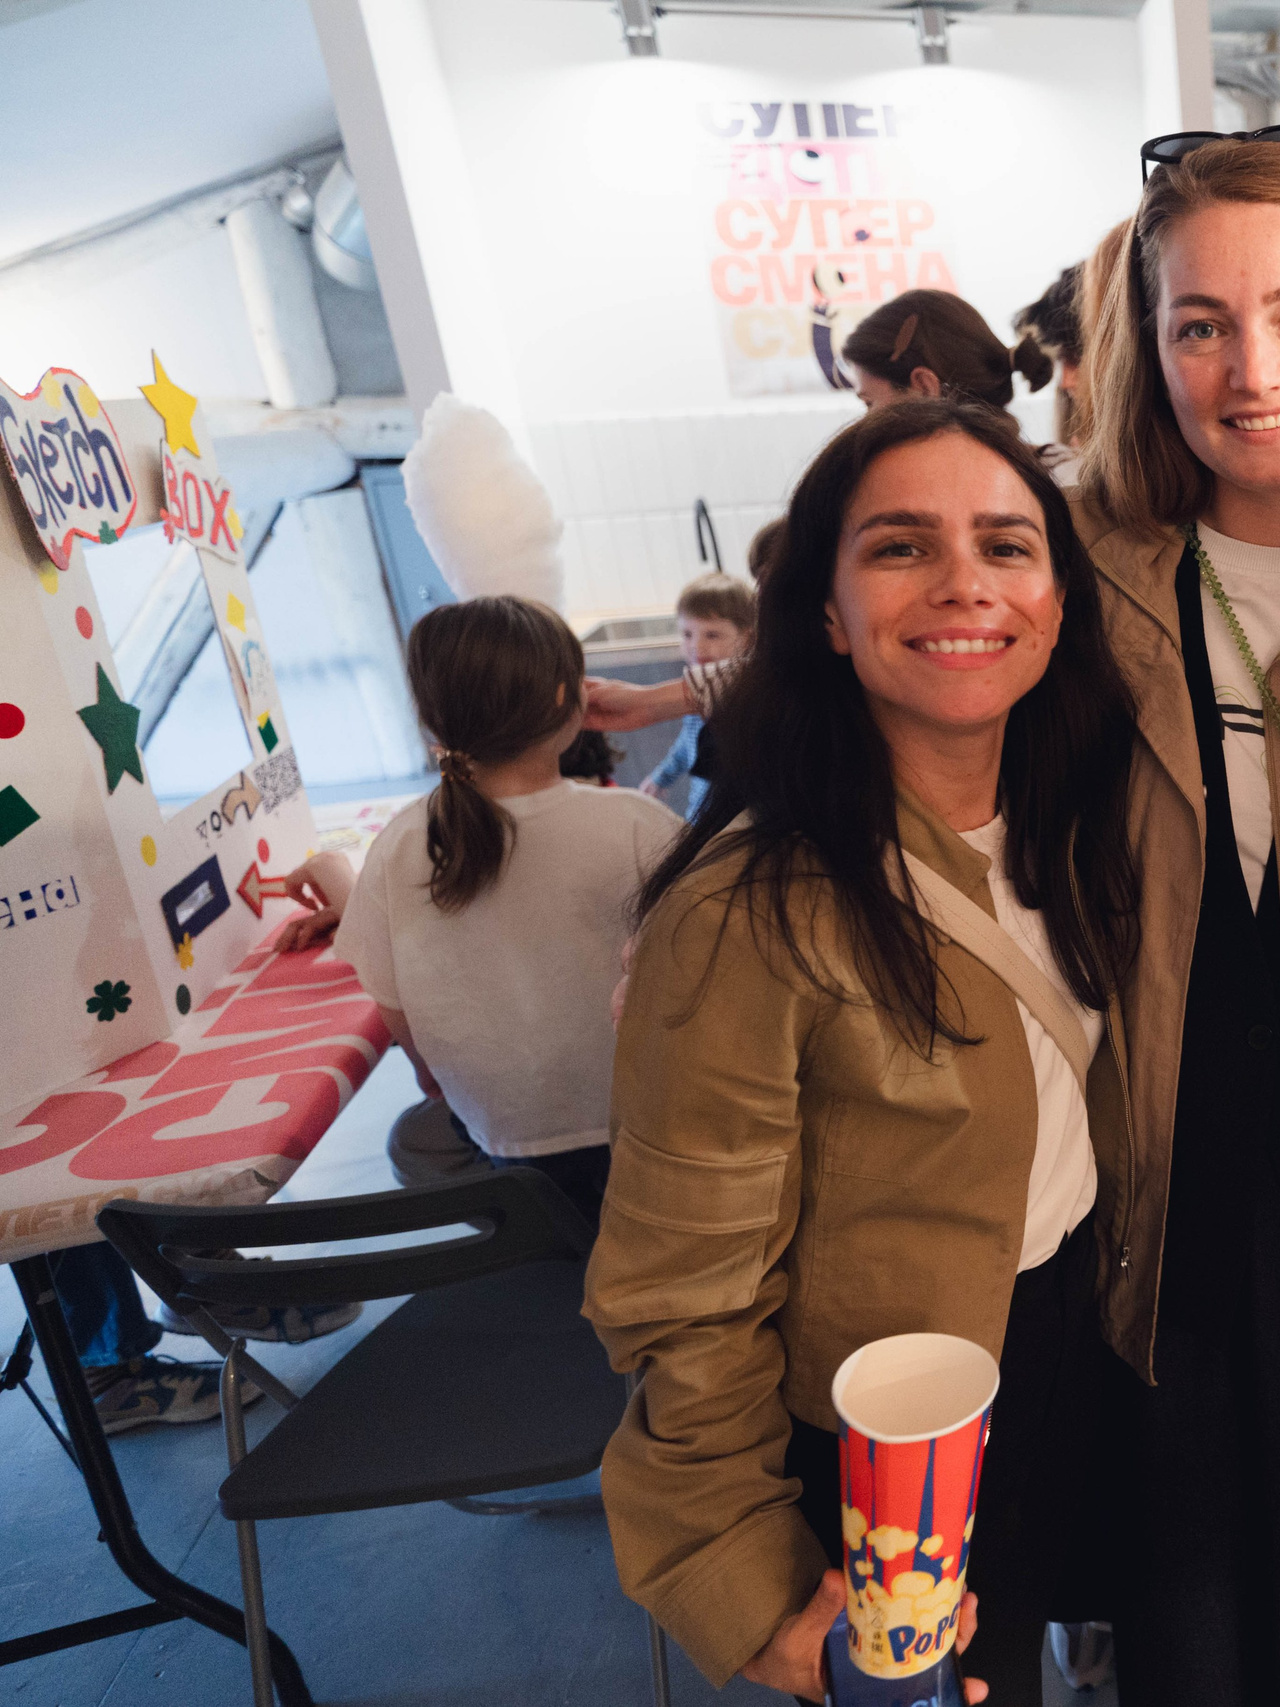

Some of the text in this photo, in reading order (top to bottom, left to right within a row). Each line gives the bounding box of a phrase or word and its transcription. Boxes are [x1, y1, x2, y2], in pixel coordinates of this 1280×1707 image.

[713, 199, 936, 251] СУПЕР
[709, 252, 962, 307] СМЕНА
[163, 455, 237, 553] BOX
